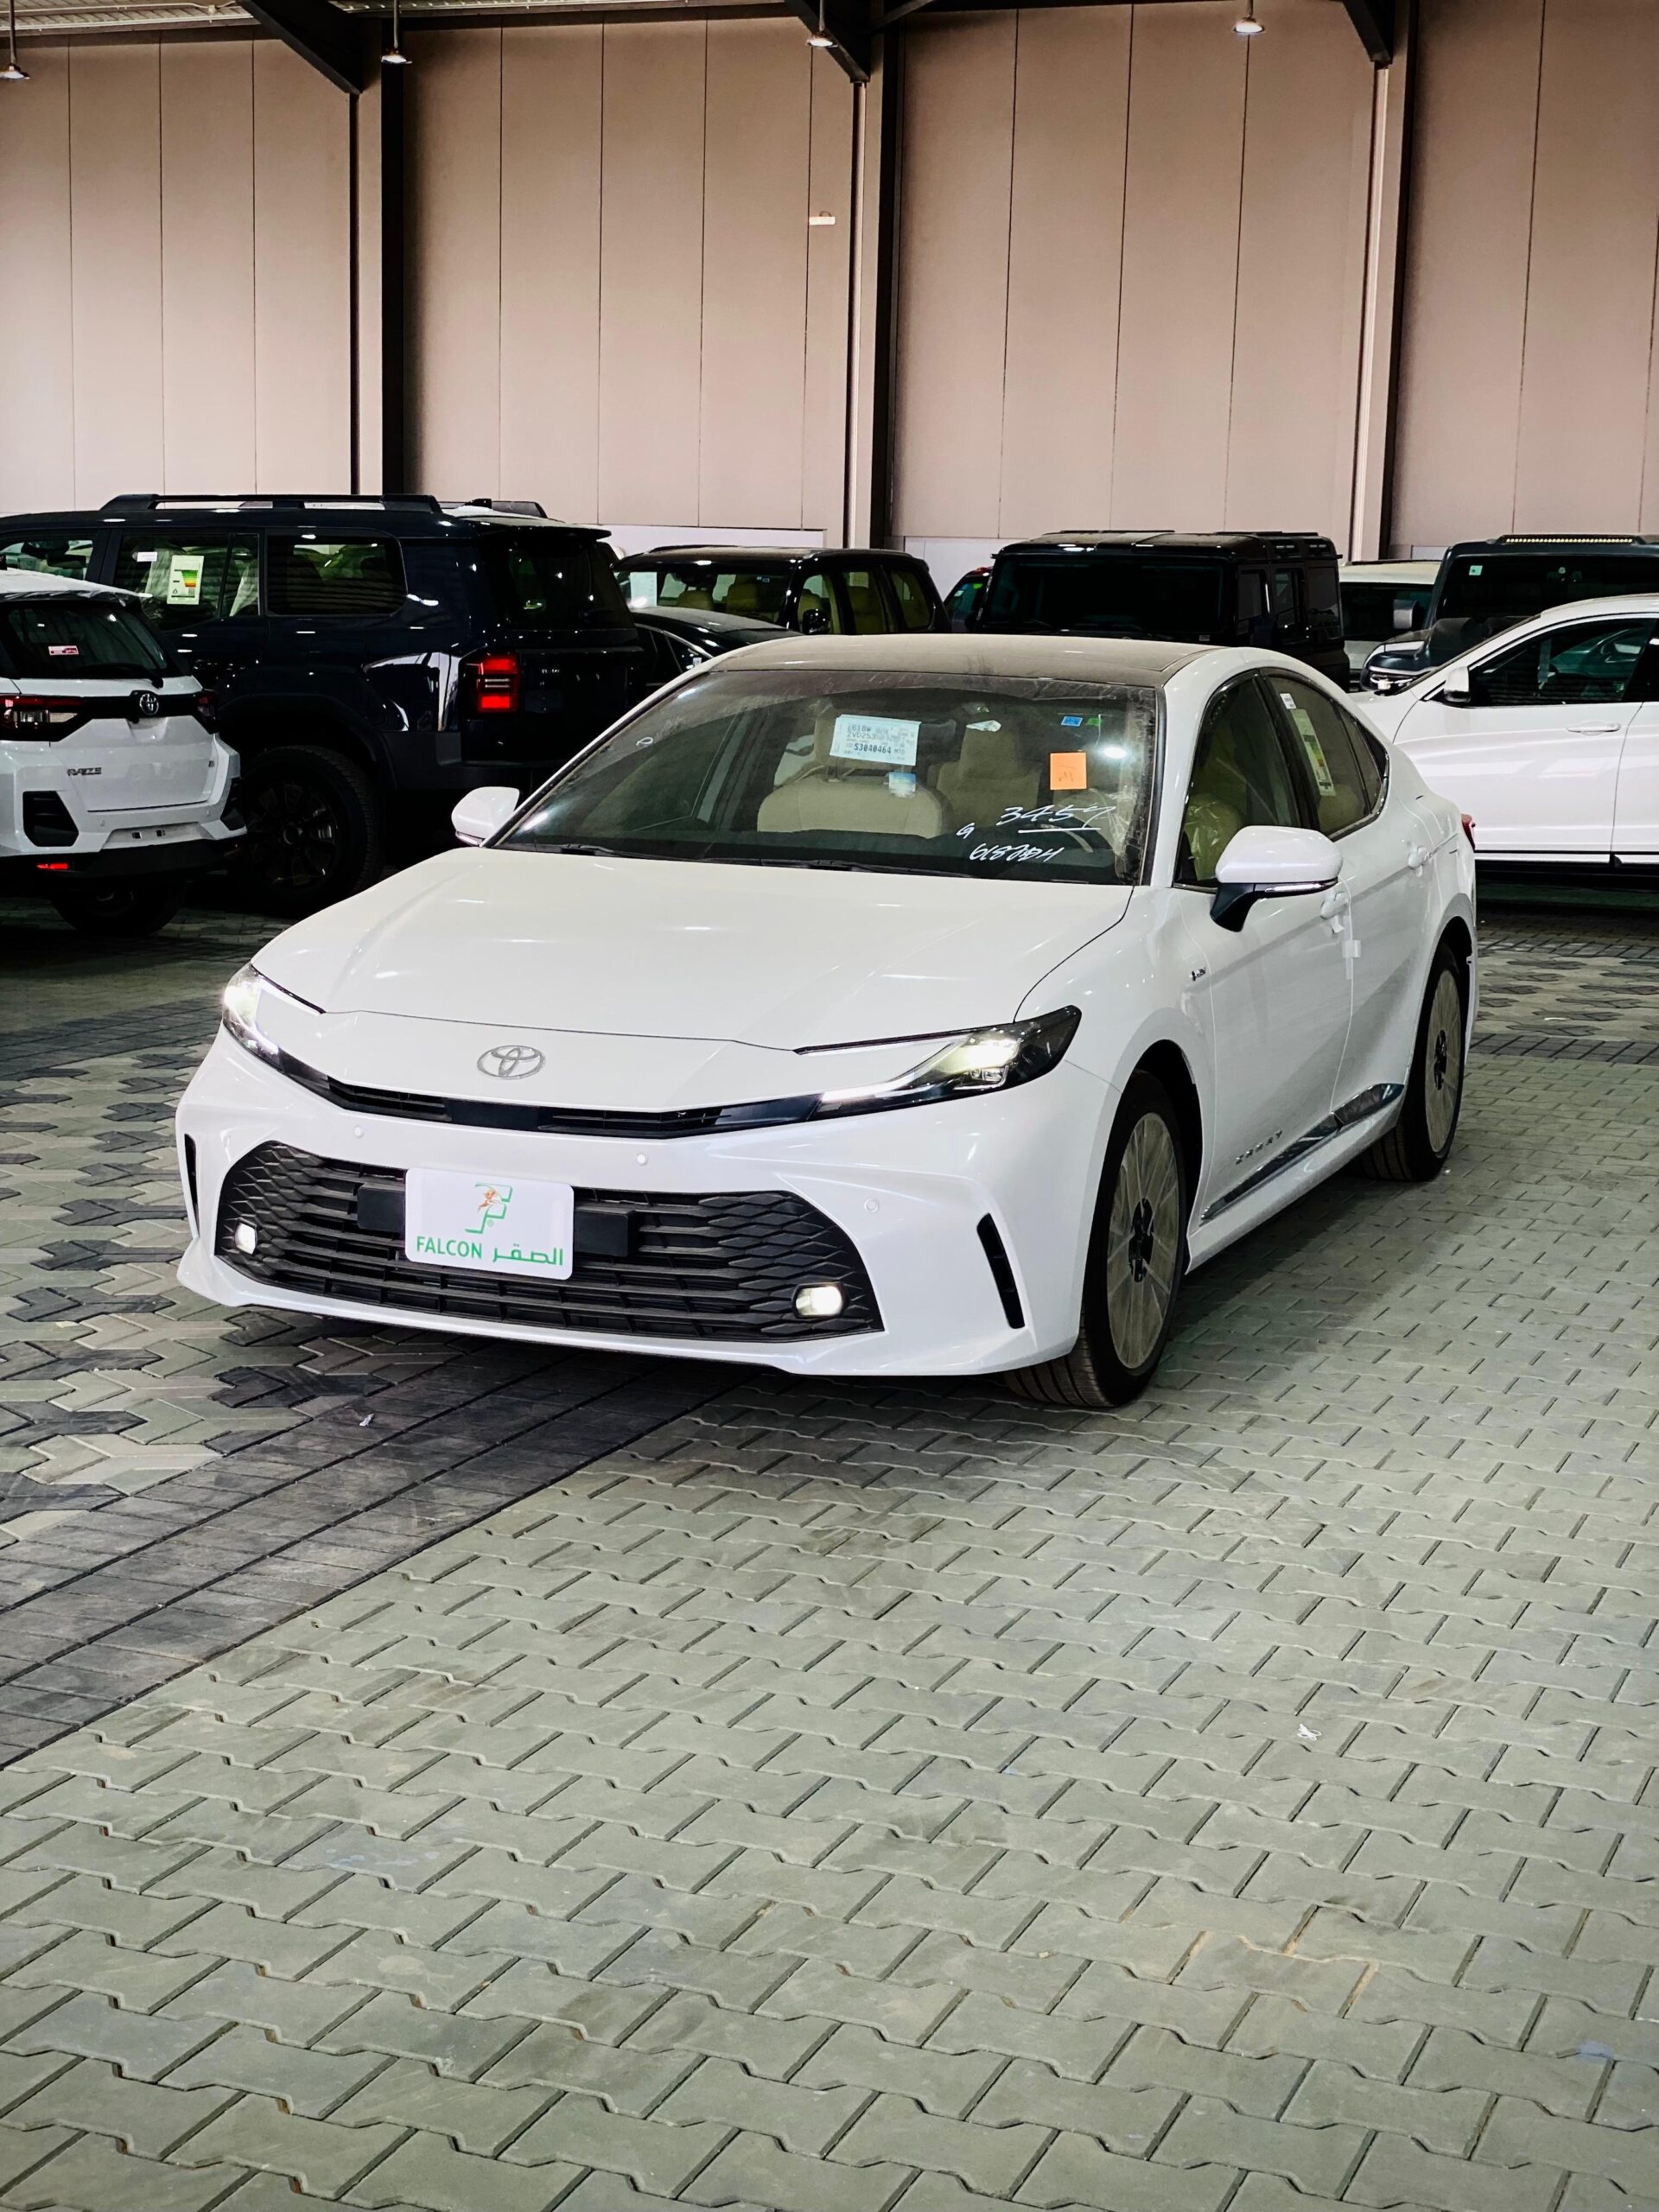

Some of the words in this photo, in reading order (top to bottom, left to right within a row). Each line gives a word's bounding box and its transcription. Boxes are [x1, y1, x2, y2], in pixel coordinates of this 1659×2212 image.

[854, 744, 892, 754] S3040464
[416, 1236, 483, 1260] FALCON
[493, 1243, 564, 1266] الصقر
